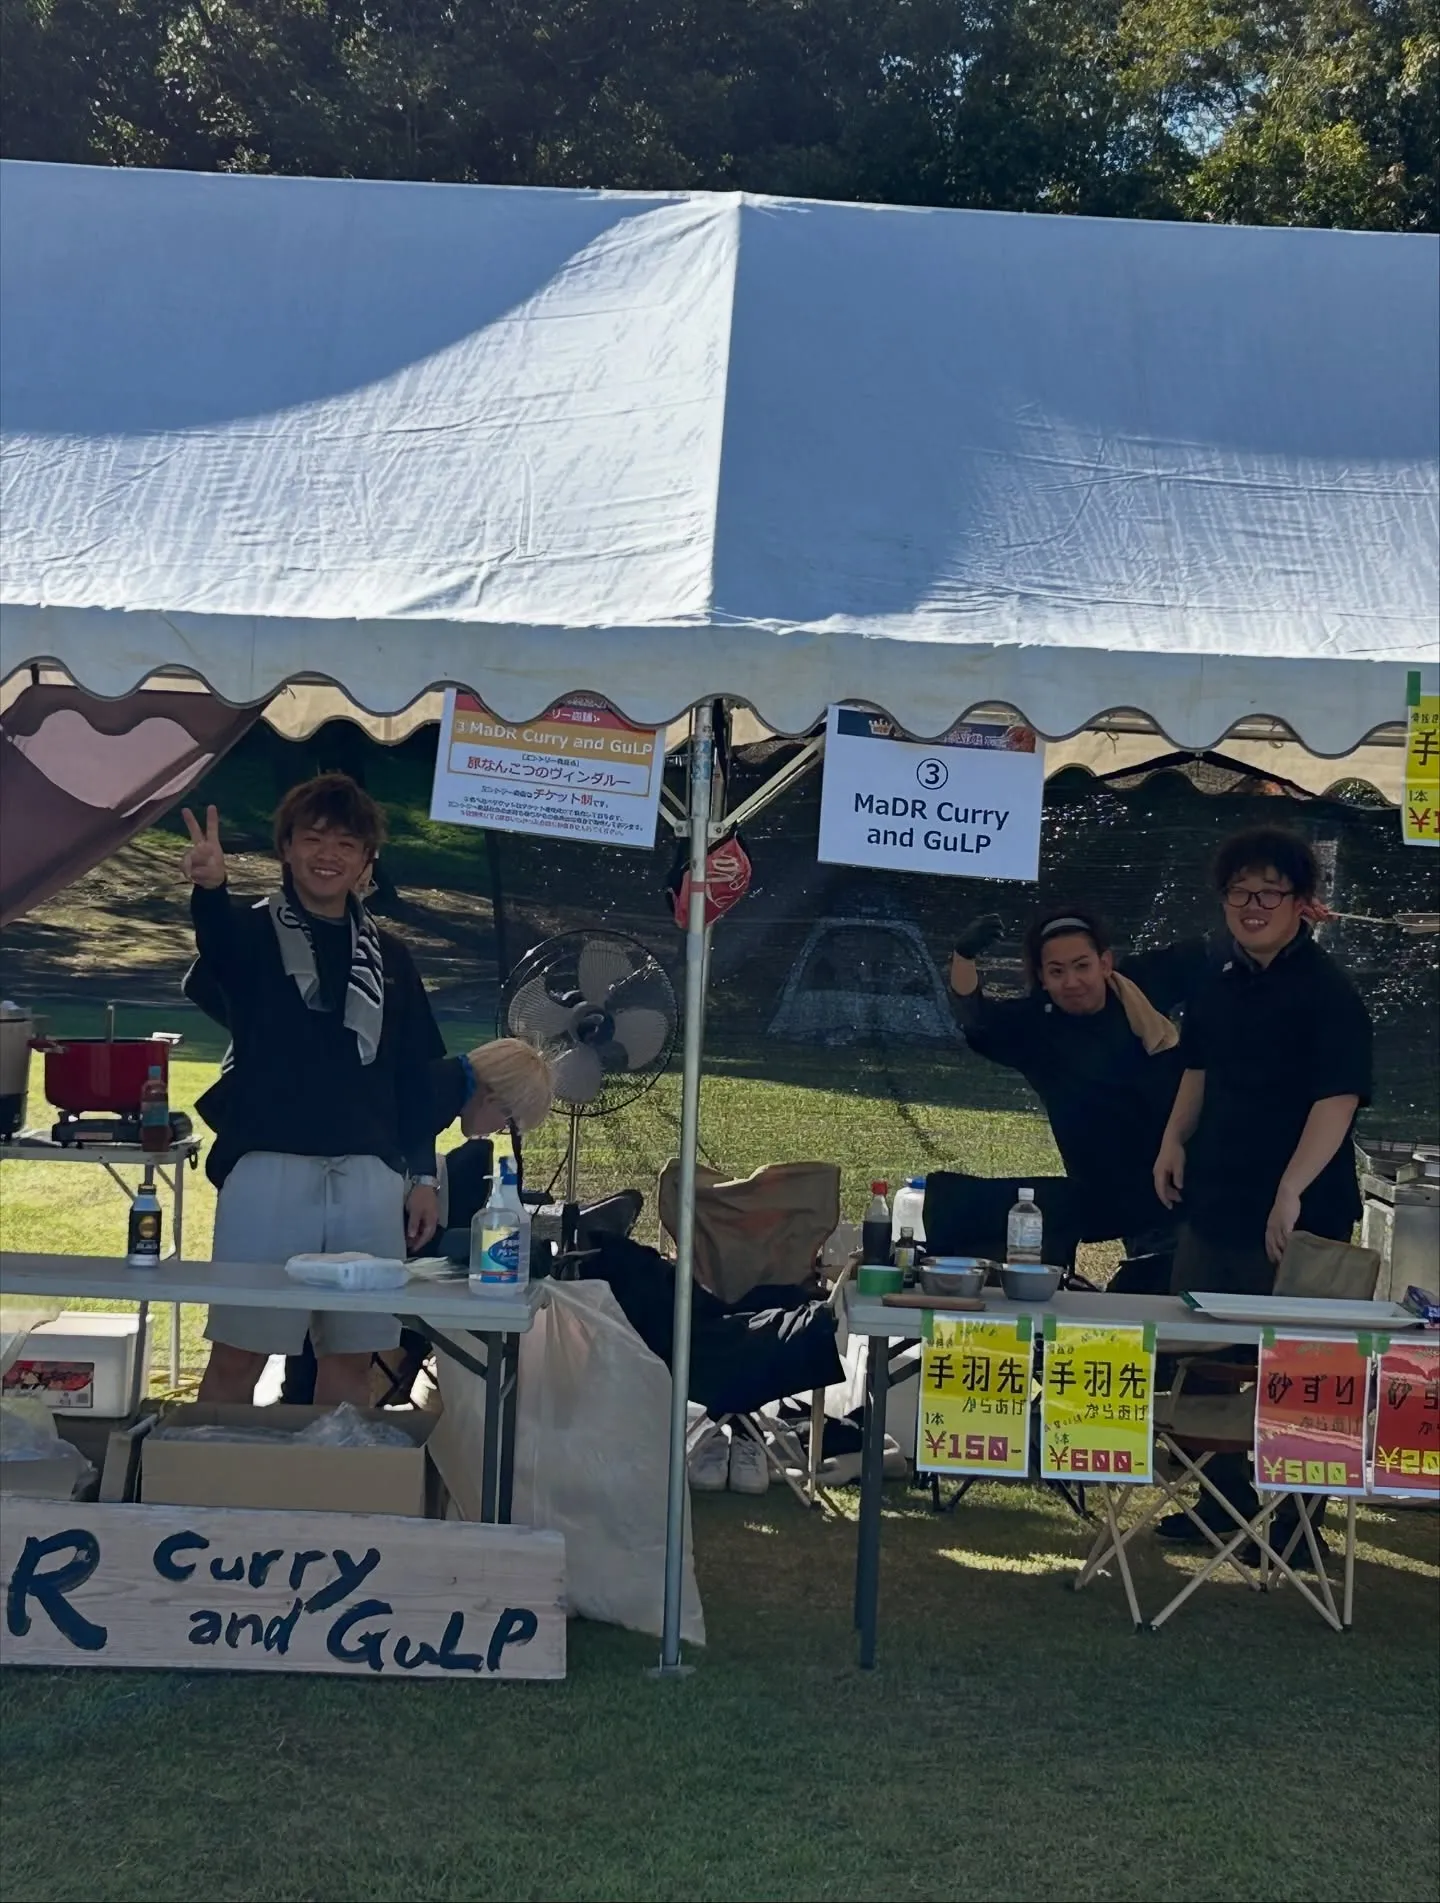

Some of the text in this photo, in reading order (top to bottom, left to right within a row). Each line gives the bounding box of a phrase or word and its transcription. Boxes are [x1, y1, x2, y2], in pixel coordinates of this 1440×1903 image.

[470, 721, 517, 740] MaDR
[522, 728, 568, 750] Curry
[573, 737, 605, 750] and
[610, 739, 653, 755] GuLP
[854, 792, 1010, 831] MaDR Curry
[867, 828, 991, 854] and GuLP
[927, 1353, 1025, 1394] 手羽先
[1049, 1359, 1147, 1399] 手羽先
[1268, 1371, 1354, 1405] 砂ずり
[926, 1412, 945, 1426] 1本
[962, 1396, 1028, 1416] からあげ
[1084, 1403, 1149, 1421] からあげ
[152, 1529, 381, 1614] Curry
[188, 1597, 538, 1672] and GuLP
